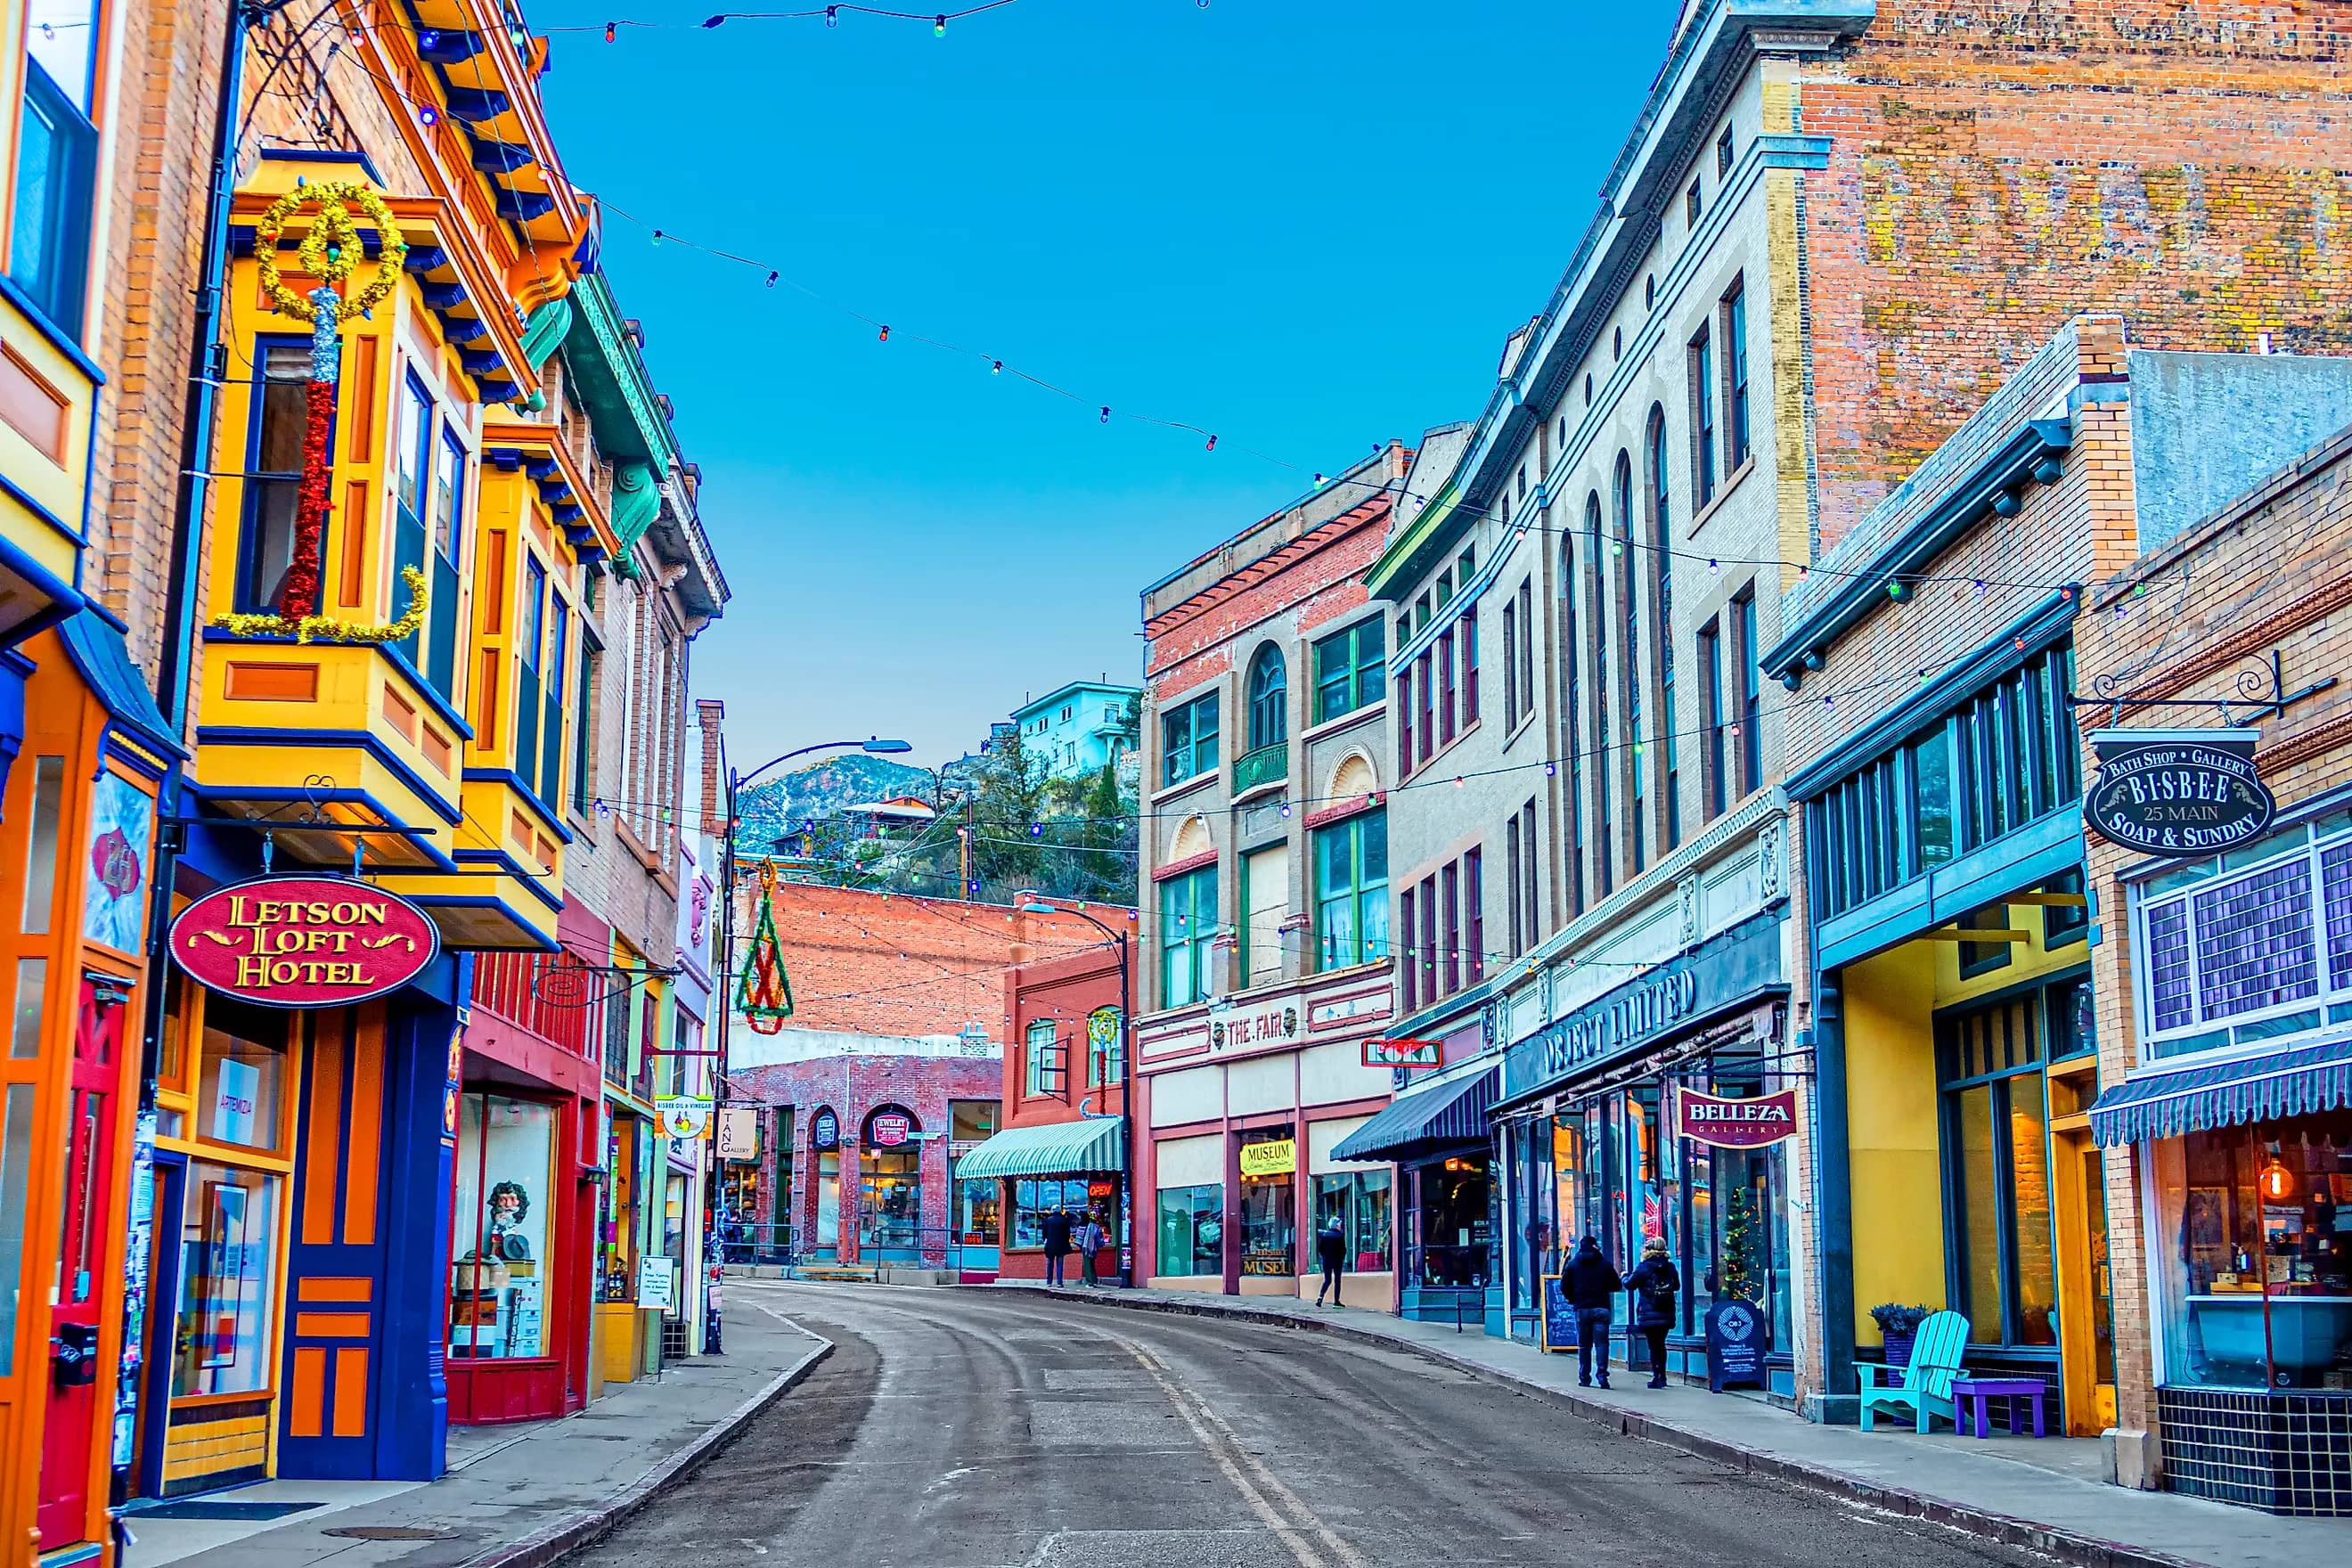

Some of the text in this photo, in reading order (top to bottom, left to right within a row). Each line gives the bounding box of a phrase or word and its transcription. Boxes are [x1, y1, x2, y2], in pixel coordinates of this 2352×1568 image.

[2107, 749, 2250, 778] BATH SHOP GALLERY
[2144, 805, 2218, 821] 25 MAIN
[2107, 812, 2258, 847] SOAP & SUNDRY
[227, 895, 388, 927] LETSON
[250, 927, 354, 955] LOFT
[233, 956, 375, 987] HOTEL
[1545, 968, 1695, 1074] OBJECT LIMITED
[1689, 1104, 1791, 1121] BELLEZA
[1698, 1125, 1779, 1134] GALLERY
[1248, 1143, 1290, 1162] MUSEUM
[1089, 1184, 1112, 1196] OPEN
